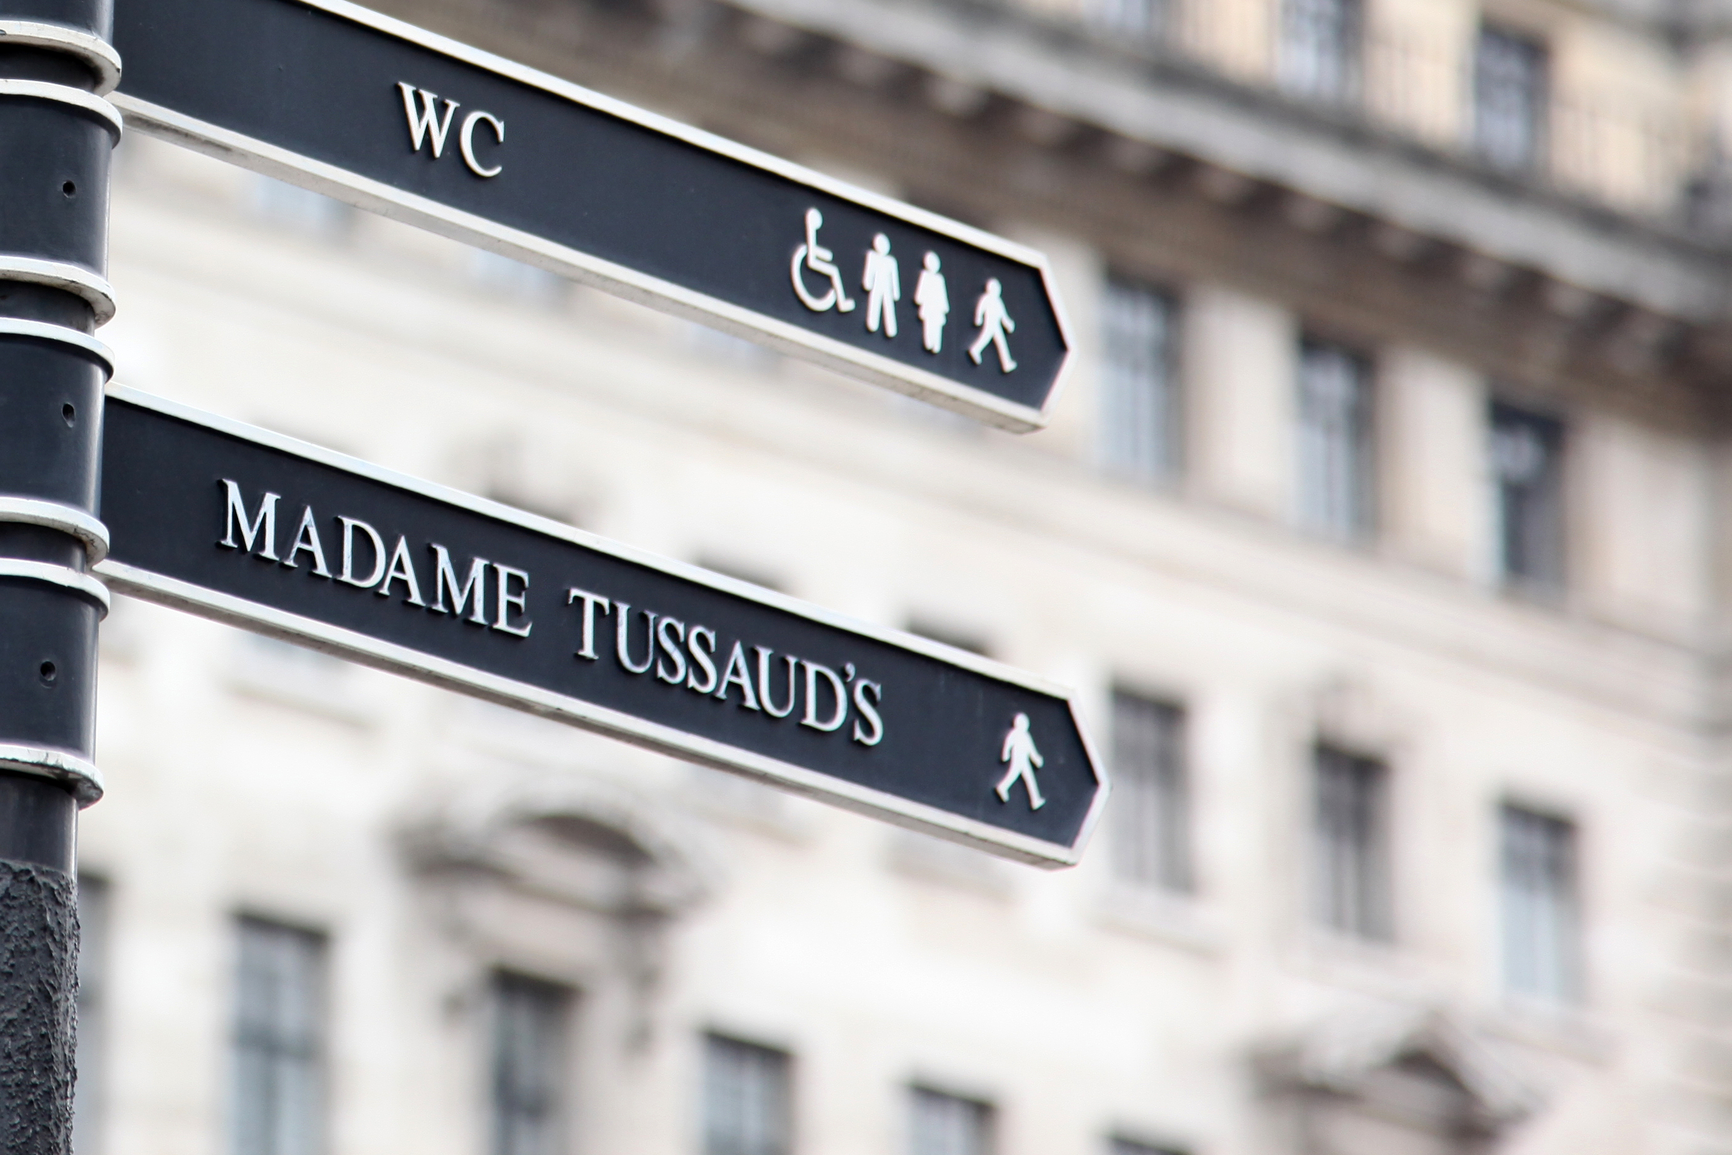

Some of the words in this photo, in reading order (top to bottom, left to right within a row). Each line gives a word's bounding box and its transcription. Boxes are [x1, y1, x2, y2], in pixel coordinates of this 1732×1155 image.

[398, 81, 505, 177] WC
[221, 478, 533, 637] MADAME
[569, 587, 884, 745] TUSSAUD'S
